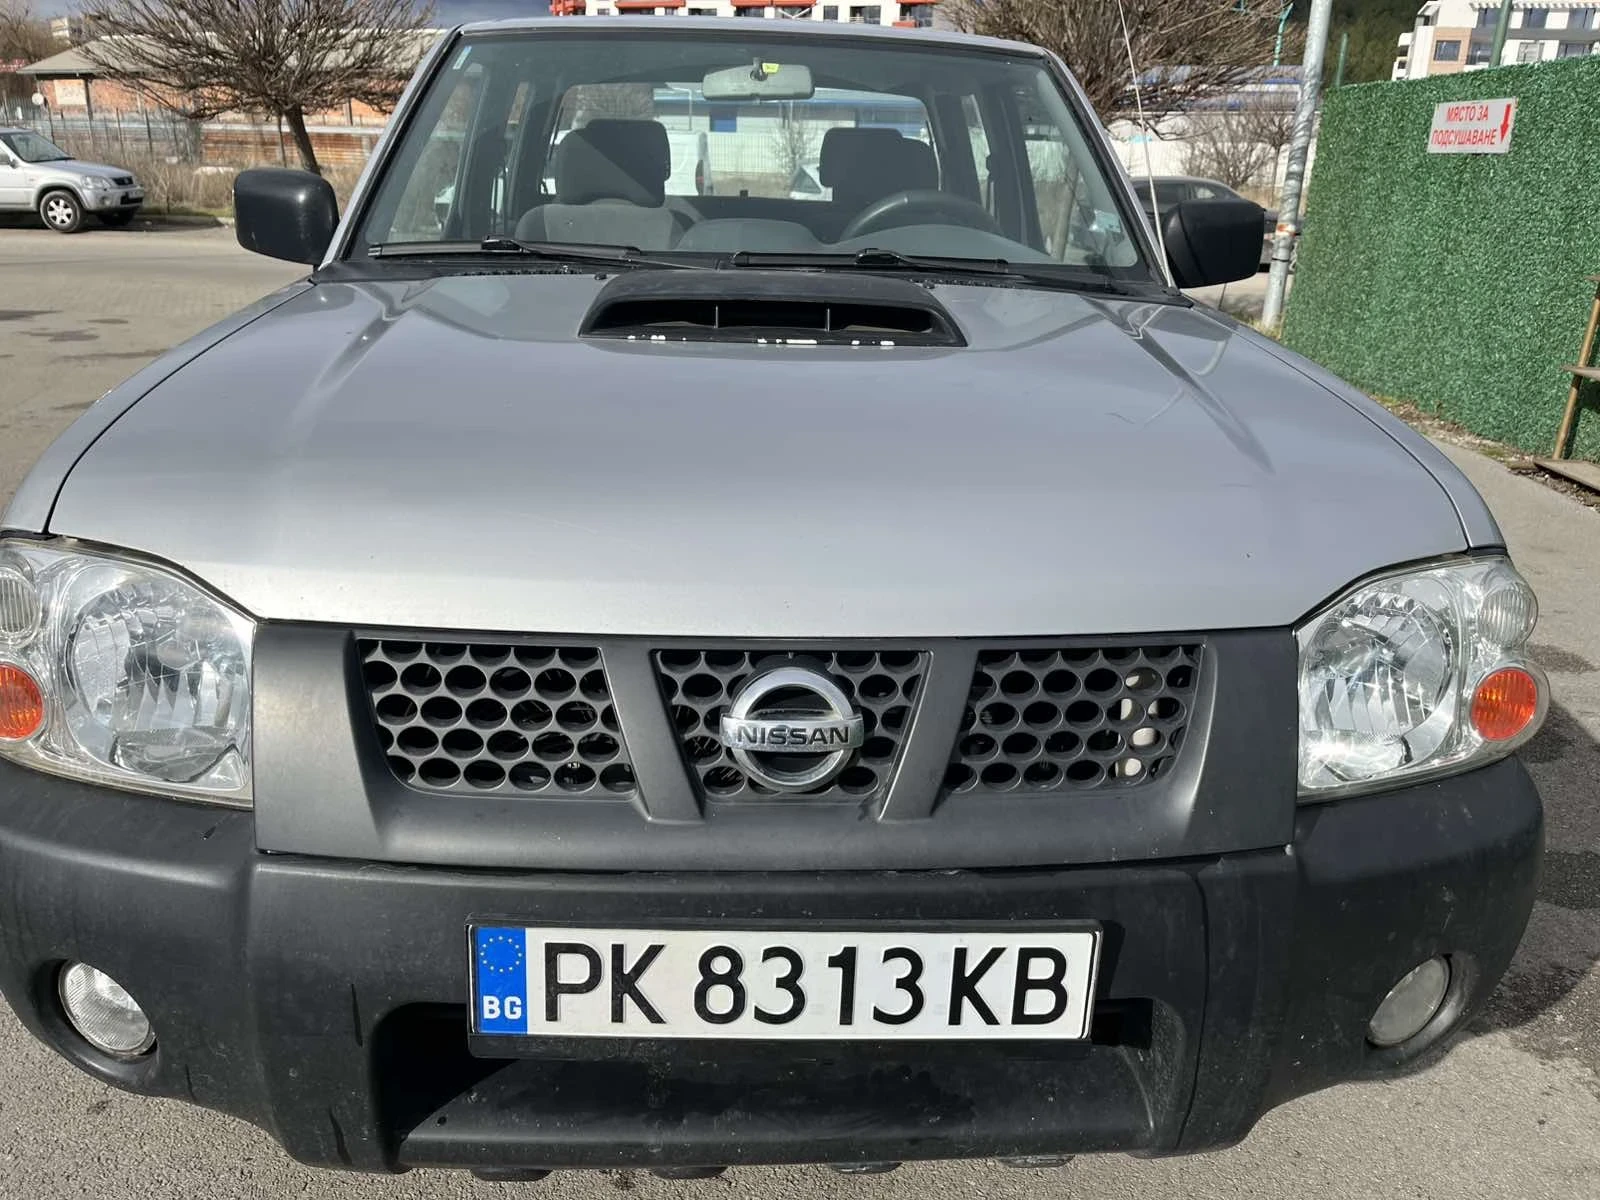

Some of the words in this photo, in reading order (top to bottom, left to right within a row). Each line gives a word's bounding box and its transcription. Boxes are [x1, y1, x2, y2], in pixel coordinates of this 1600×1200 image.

[1446, 106, 1476, 122] МЯСТО
[1478, 105, 1489, 121] ЗА
[1431, 129, 1497, 147] ПОДСУШАВАНЕ
[737, 726, 849, 745] NISSAN
[545, 942, 667, 1024] PK
[694, 945, 925, 1026] 8313
[948, 947, 1068, 1026] KB
[483, 995, 522, 1020] BG
